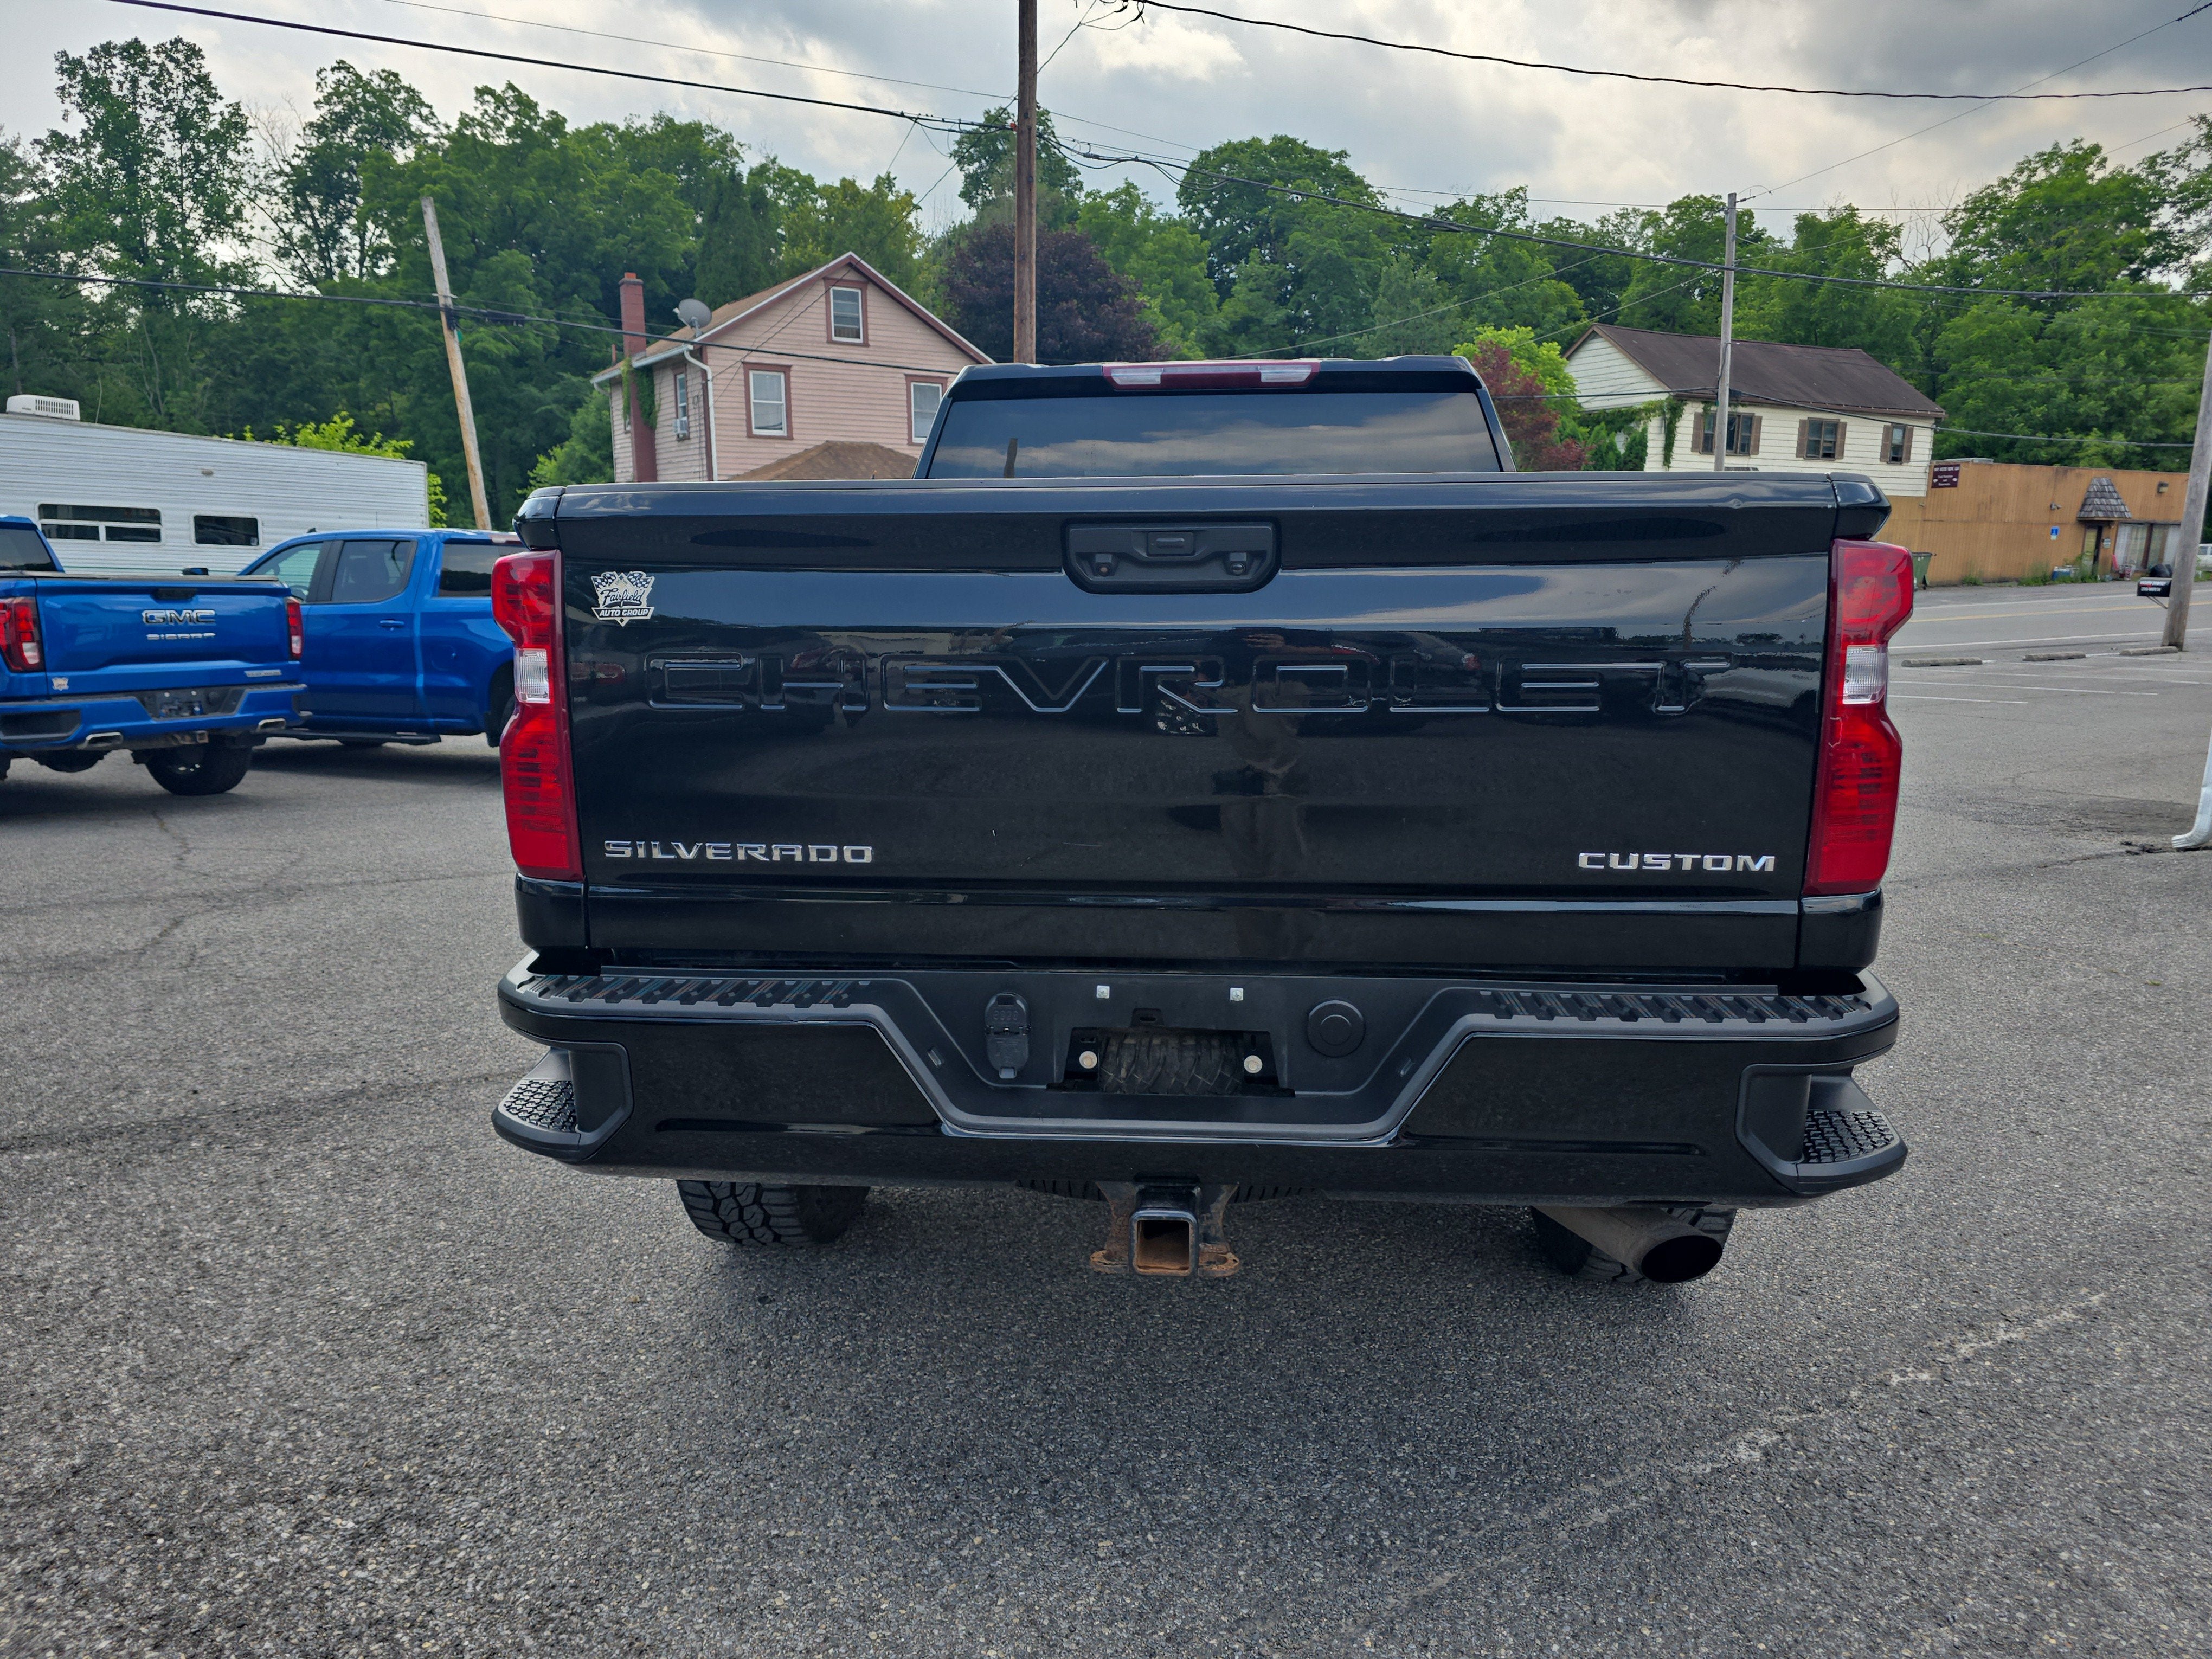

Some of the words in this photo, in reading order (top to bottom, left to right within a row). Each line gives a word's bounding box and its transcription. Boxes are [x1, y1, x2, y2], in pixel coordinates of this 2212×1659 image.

[600, 588, 645, 607] Fairfield
[142, 609, 216, 626] GMC
[645, 652, 1732, 715] CHEVROLET
[605, 840, 873, 863] SILVERADO
[1578, 853, 1776, 871] CUSTOM
